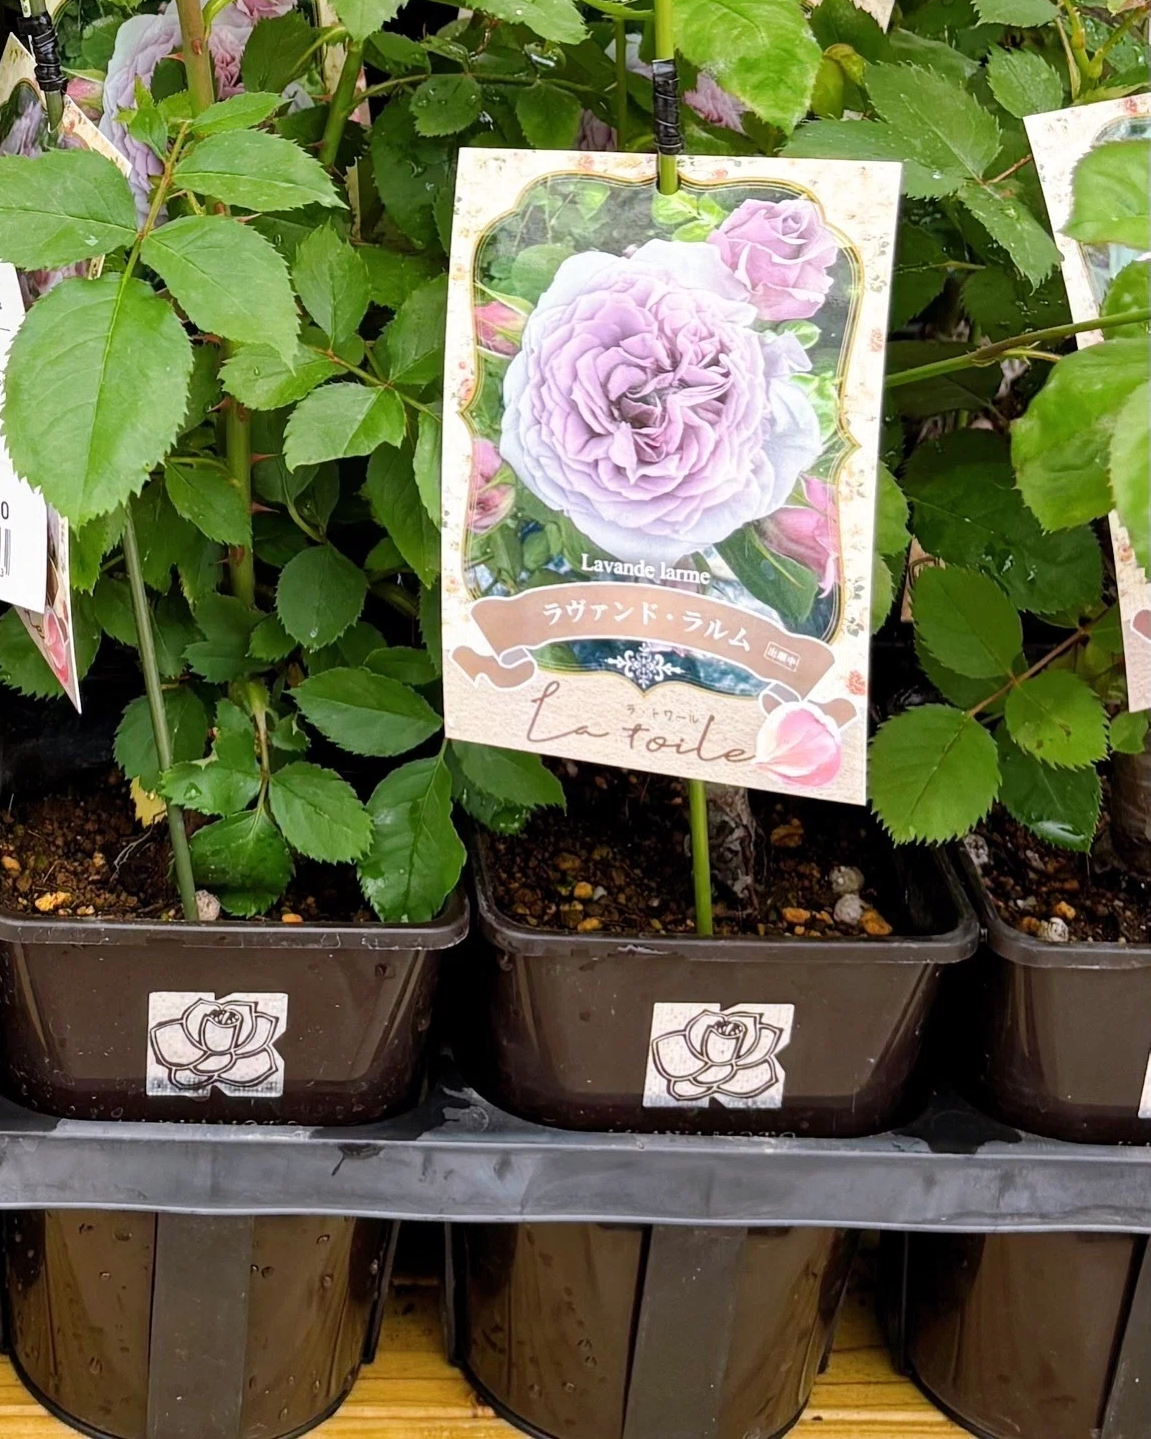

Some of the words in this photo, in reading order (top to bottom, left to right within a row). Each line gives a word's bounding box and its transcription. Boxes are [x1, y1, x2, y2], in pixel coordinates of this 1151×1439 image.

[581, 553, 655, 582] Lavande
[660, 557, 711, 585] larme
[541, 598, 752, 652] ラヴァンド・ラルム
[526, 681, 610, 744] La
[622, 714, 758, 764] toile
